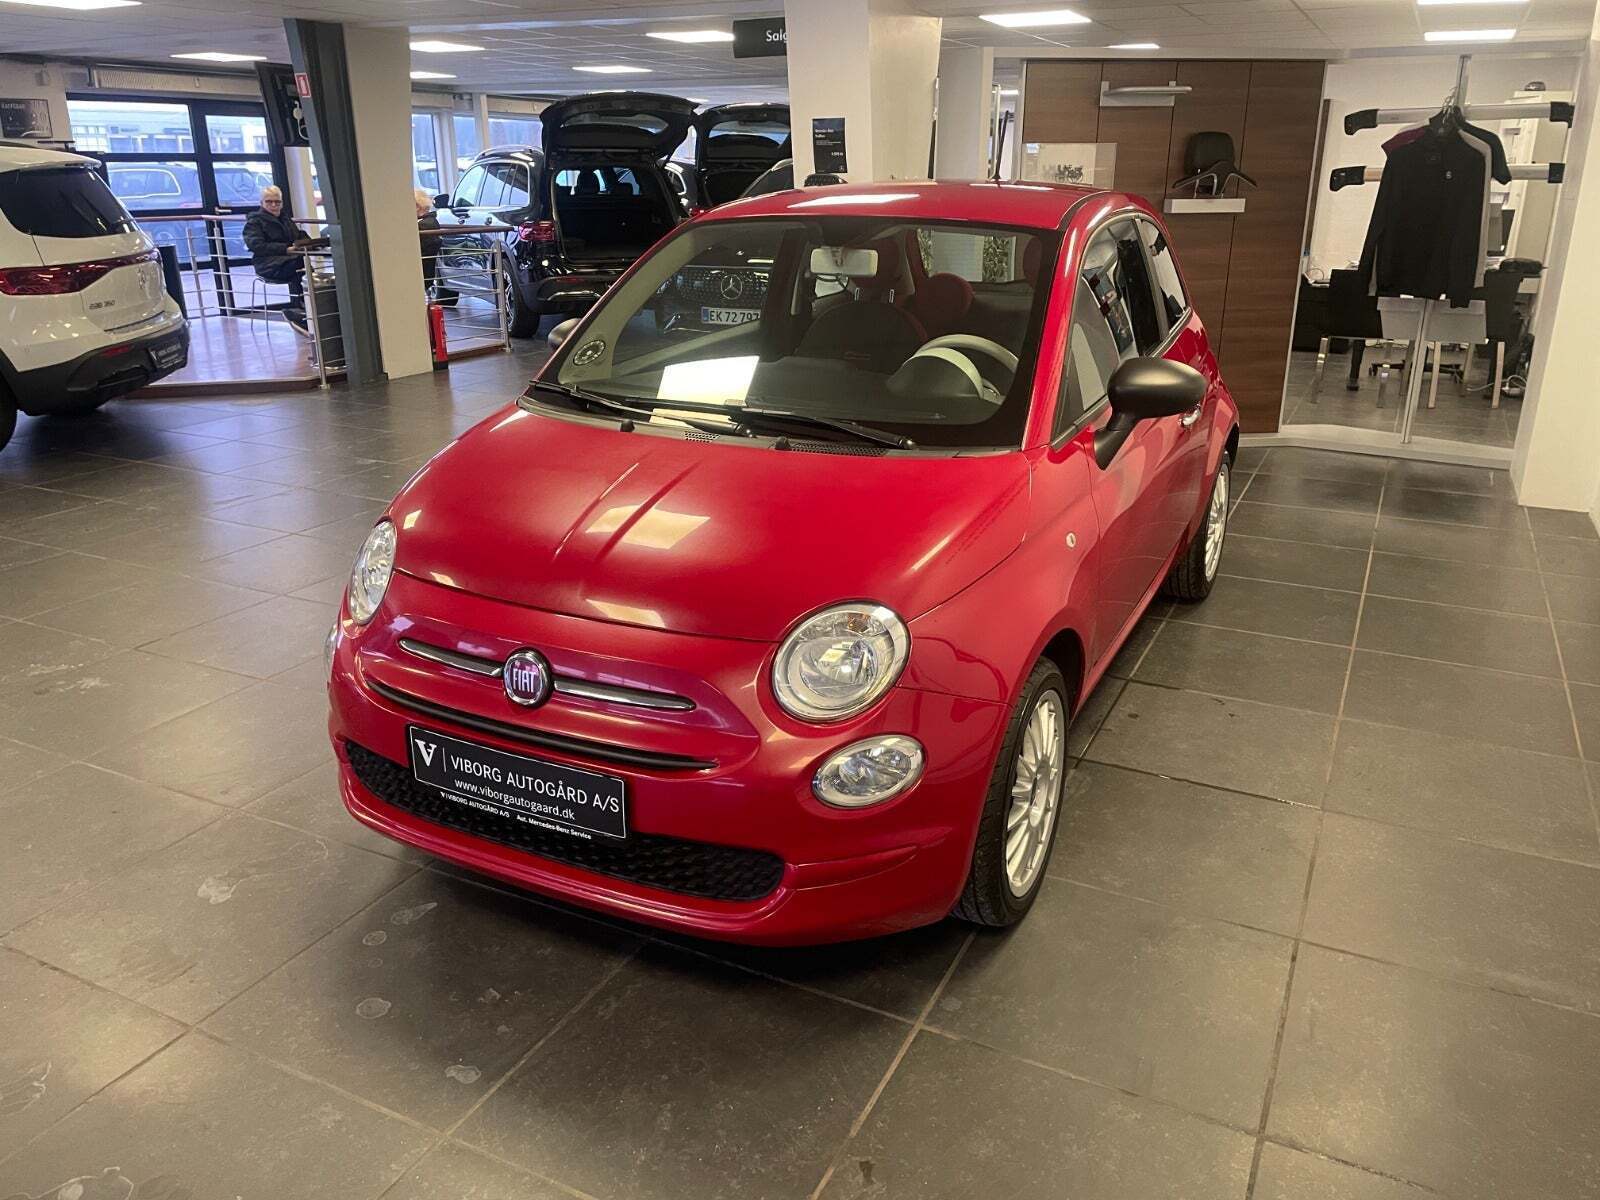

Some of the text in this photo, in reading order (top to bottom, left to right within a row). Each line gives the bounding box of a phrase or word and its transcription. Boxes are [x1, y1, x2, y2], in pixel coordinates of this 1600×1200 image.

[709, 310, 722, 322] EK
[725, 311, 738, 323] 72
[512, 667, 536, 692] FIAT
[450, 754, 620, 813] VIBORG AUTOGÅRD A/S
[454, 779, 575, 820] www.viborgautogaard.dk
[447, 793, 468, 805] VIBORG
[468, 800, 499, 815] AUTOGÅRD
[499, 809, 510, 818] A/S
[570, 828, 592, 840] Service
